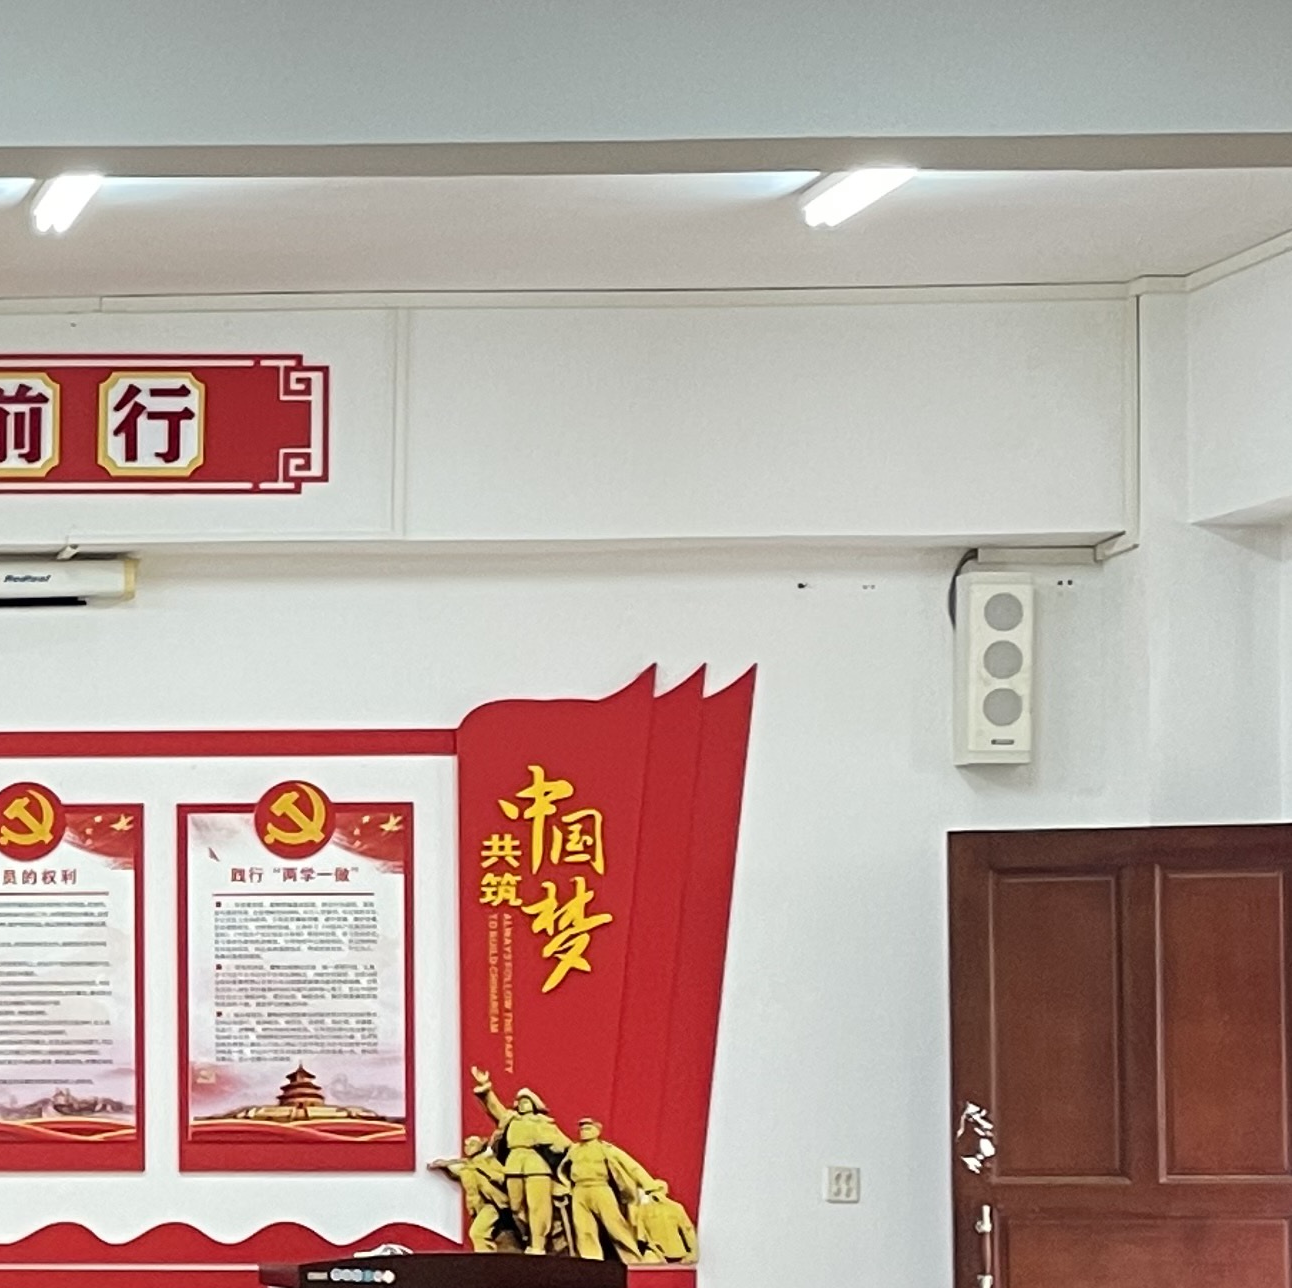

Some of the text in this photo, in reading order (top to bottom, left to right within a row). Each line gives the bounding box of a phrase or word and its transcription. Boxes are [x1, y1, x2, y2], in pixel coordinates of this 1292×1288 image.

[479, 833, 523, 907] 共筑
[497, 764, 614, 993] 中国梦
